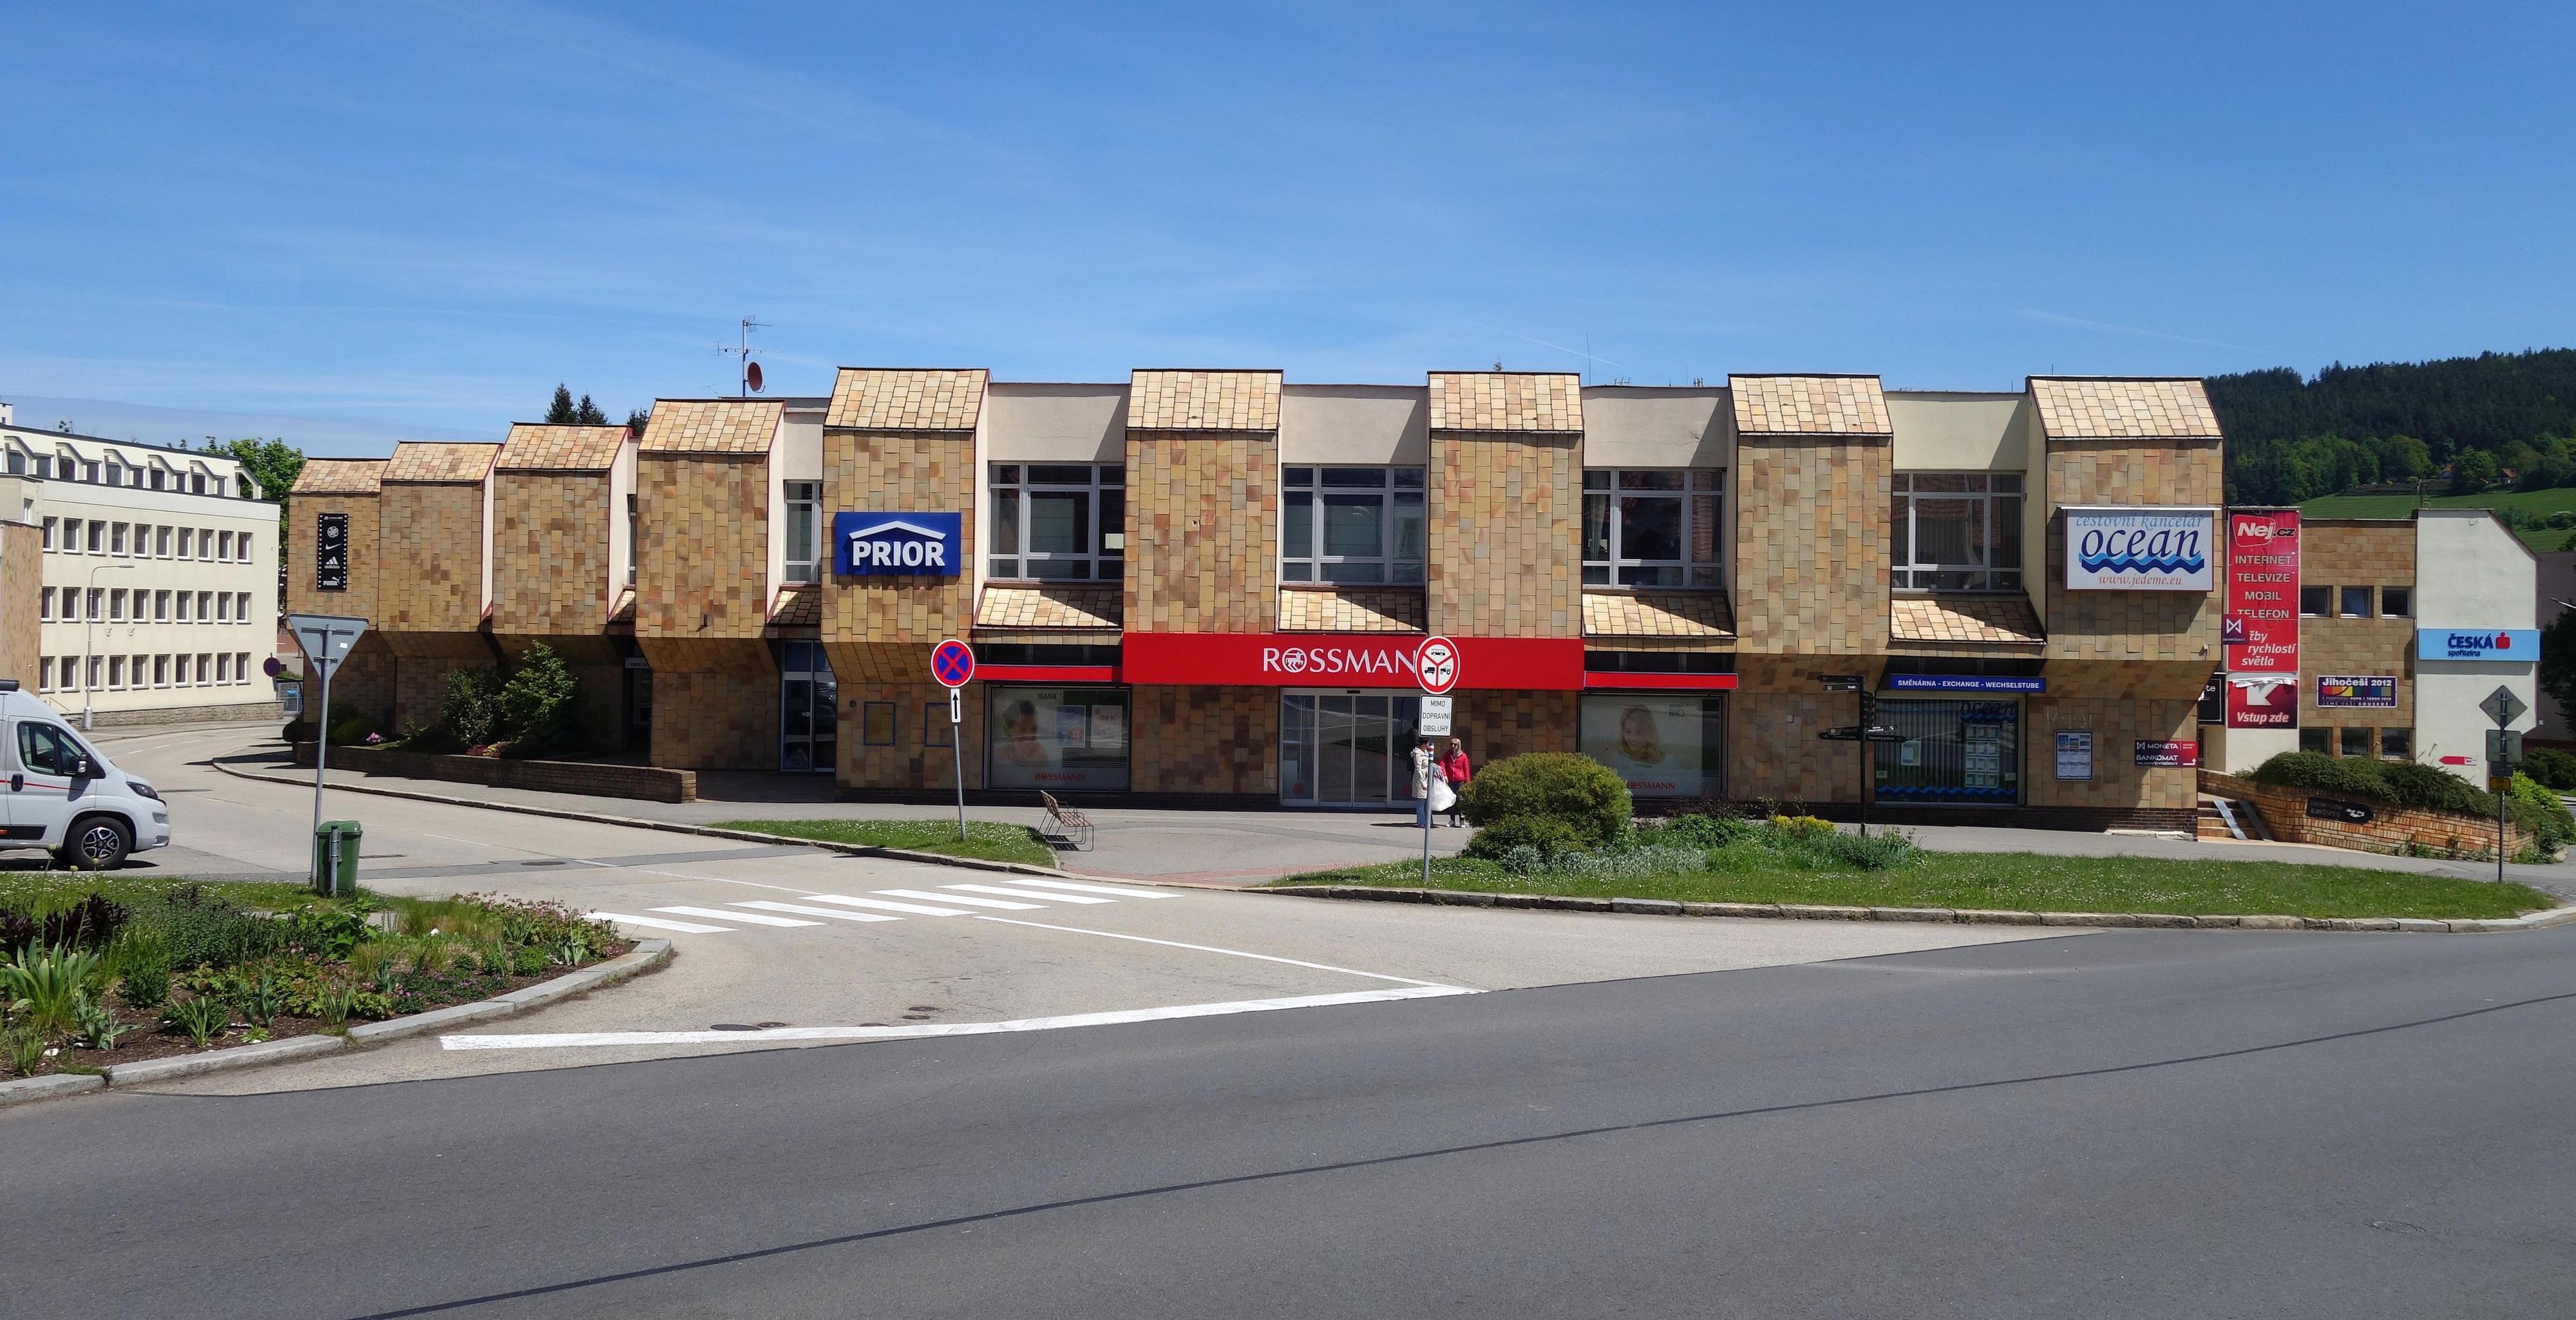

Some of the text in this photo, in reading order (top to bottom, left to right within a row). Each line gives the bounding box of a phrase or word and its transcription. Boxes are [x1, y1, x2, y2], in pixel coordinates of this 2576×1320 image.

[2081, 529, 2201, 558] ocean
[853, 541, 945, 566] PRIOR
[2235, 555, 2292, 564] INTERNET
[2098, 573, 2182, 588] www.jedeme.eu
[2237, 573, 2290, 582] TELEVIZE
[2245, 591, 2282, 600] MOBIL
[2448, 633, 2494, 649] ČESKÁ
[2248, 644, 2297, 656] rychlostí
[1263, 647, 1417, 674] ROSSMAN
[2242, 656, 2275, 666] světla
[2322, 678, 2368, 686] Jihočeši
[2237, 712, 2289, 723] Vstup zde
[1035, 773, 1085, 781] ROSSMANN
